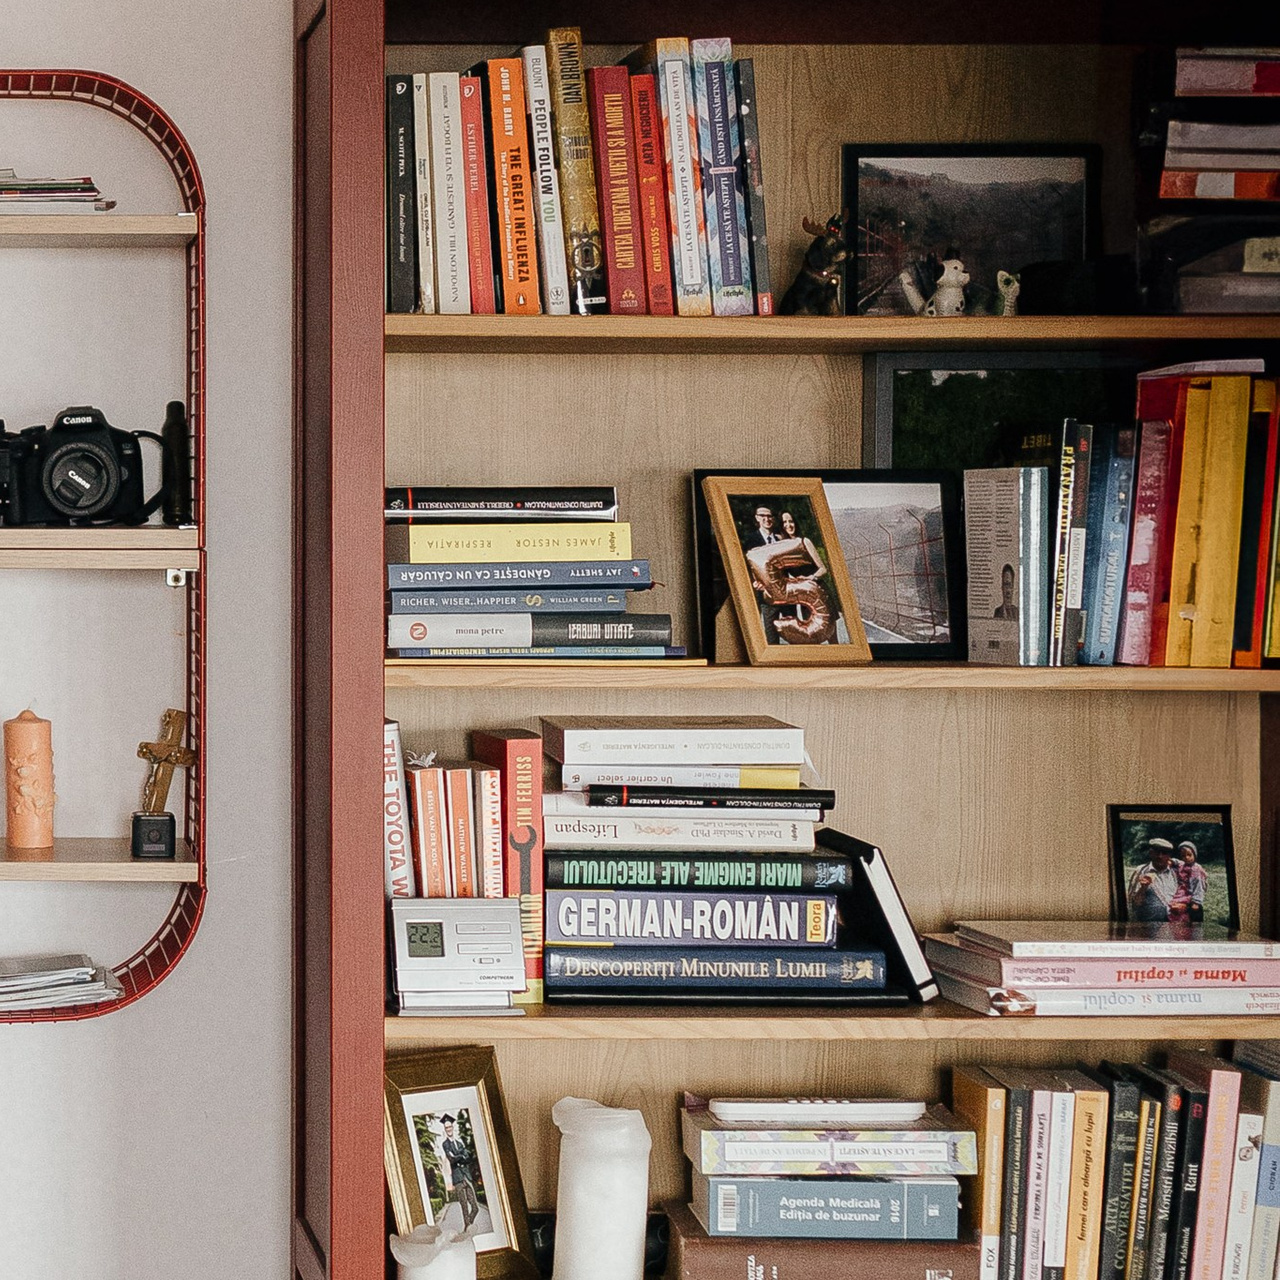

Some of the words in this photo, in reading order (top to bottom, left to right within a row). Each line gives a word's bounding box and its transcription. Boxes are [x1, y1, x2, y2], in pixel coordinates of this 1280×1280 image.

[560, 42, 579, 81] BROWN
[499, 67, 510, 91] JOHN
[531, 58, 544, 89] BLOUNT
[562, 82, 581, 104] DAN
[443, 114, 452, 145] BOGAT
[503, 107, 515, 136] BARRY
[533, 99, 549, 143] PEOPLE
[467, 123, 477, 159] ESTHER
[500, 152, 508, 162] The
[509, 147, 522, 170] THE
[640, 140, 654, 165] ARTA
[469, 161, 479, 193] PEREL
[538, 146, 554, 195] FOLLOW
[511, 174, 526, 211] GREAT
[543, 200, 556, 223] YOU
[723, 209, 731, 220] TE
[650, 227, 660, 247] VOSS
[725, 232, 732, 242] CE
[513, 217, 529, 283] INFLUENZA
[614, 233, 635, 269] CARTEA
[726, 243, 734, 254] LA
[652, 249, 662, 272] CHRIS
[62, 416, 92, 425] Canon
[68, 470, 91, 490] Canon
[515, 538, 560, 548] NESTOR
[565, 537, 601, 548] JAMES
[401, 571, 453, 582] CĂLUGĂR
[456, 570, 472, 579] UN
[474, 570, 491, 579] CA
[494, 566, 551, 580] GÂNDEȘTE
[570, 568, 603, 577] SHETTY
[605, 568, 622, 577] JAY
[476, 597, 516, 605] HAPPIER
[456, 627, 480, 635] mona
[481, 626, 505, 636] petre
[383, 739, 398, 782] THE
[516, 756, 532, 803] FERRISS
[597, 775, 625, 784] select
[626, 775, 658, 784] cartier
[660, 775, 673, 784] Un
[383, 788, 405, 871] TOYOTA
[458, 818, 466, 852] MATTHEW
[555, 820, 618, 839] Lifespan
[690, 828, 711, 838] PhD
[712, 828, 743, 839] Sinclair
[754, 829, 782, 839] David
[460, 854, 468, 883] WALKER
[563, 860, 656, 885] TRECUTULUI
[661, 862, 689, 886] ALE
[695, 862, 756, 886] ENIGME
[760, 862, 802, 887] MARI
[558, 895, 800, 941] GERMAN-ROMÂN
[808, 903, 822, 940] Teora
[774, 958, 827, 978] LUMII
[1116, 966, 1175, 983] copilul
[1193, 969, 1248, 982] Mama
[1082, 992, 1135, 1010] copilul
[1156, 993, 1202, 1006] mama
[1084, 1111, 1095, 1133] lupii
[1085, 1136, 1092, 1147] cu
[1143, 1127, 1155, 1166] RICHEST
[1163, 1121, 1179, 1175] invizibili
[1141, 1168, 1151, 1190] MAN
[1183, 1163, 1199, 1191] Rant
[1268, 1160, 1278, 1191] CIORAN
[779, 1196, 825, 1209] Agenda
[828, 1196, 881, 1208] Medicală
[1080, 1190, 1089, 1211] care
[1158, 1177, 1172, 1221] Monștri
[779, 1208, 813, 1221] Ediția
[815, 1209, 830, 1219] de
[832, 1210, 881, 1221] buzunar
[889, 1198, 900, 1223] 2016
[1105, 1196, 1119, 1235] ARTA
[1136, 1197, 1148, 1240] BABYLON
[1077, 1214, 1087, 1241] femei
[1178, 1227, 1191, 1265] Palahniuk
[985, 1247, 996, 1269] FOX
